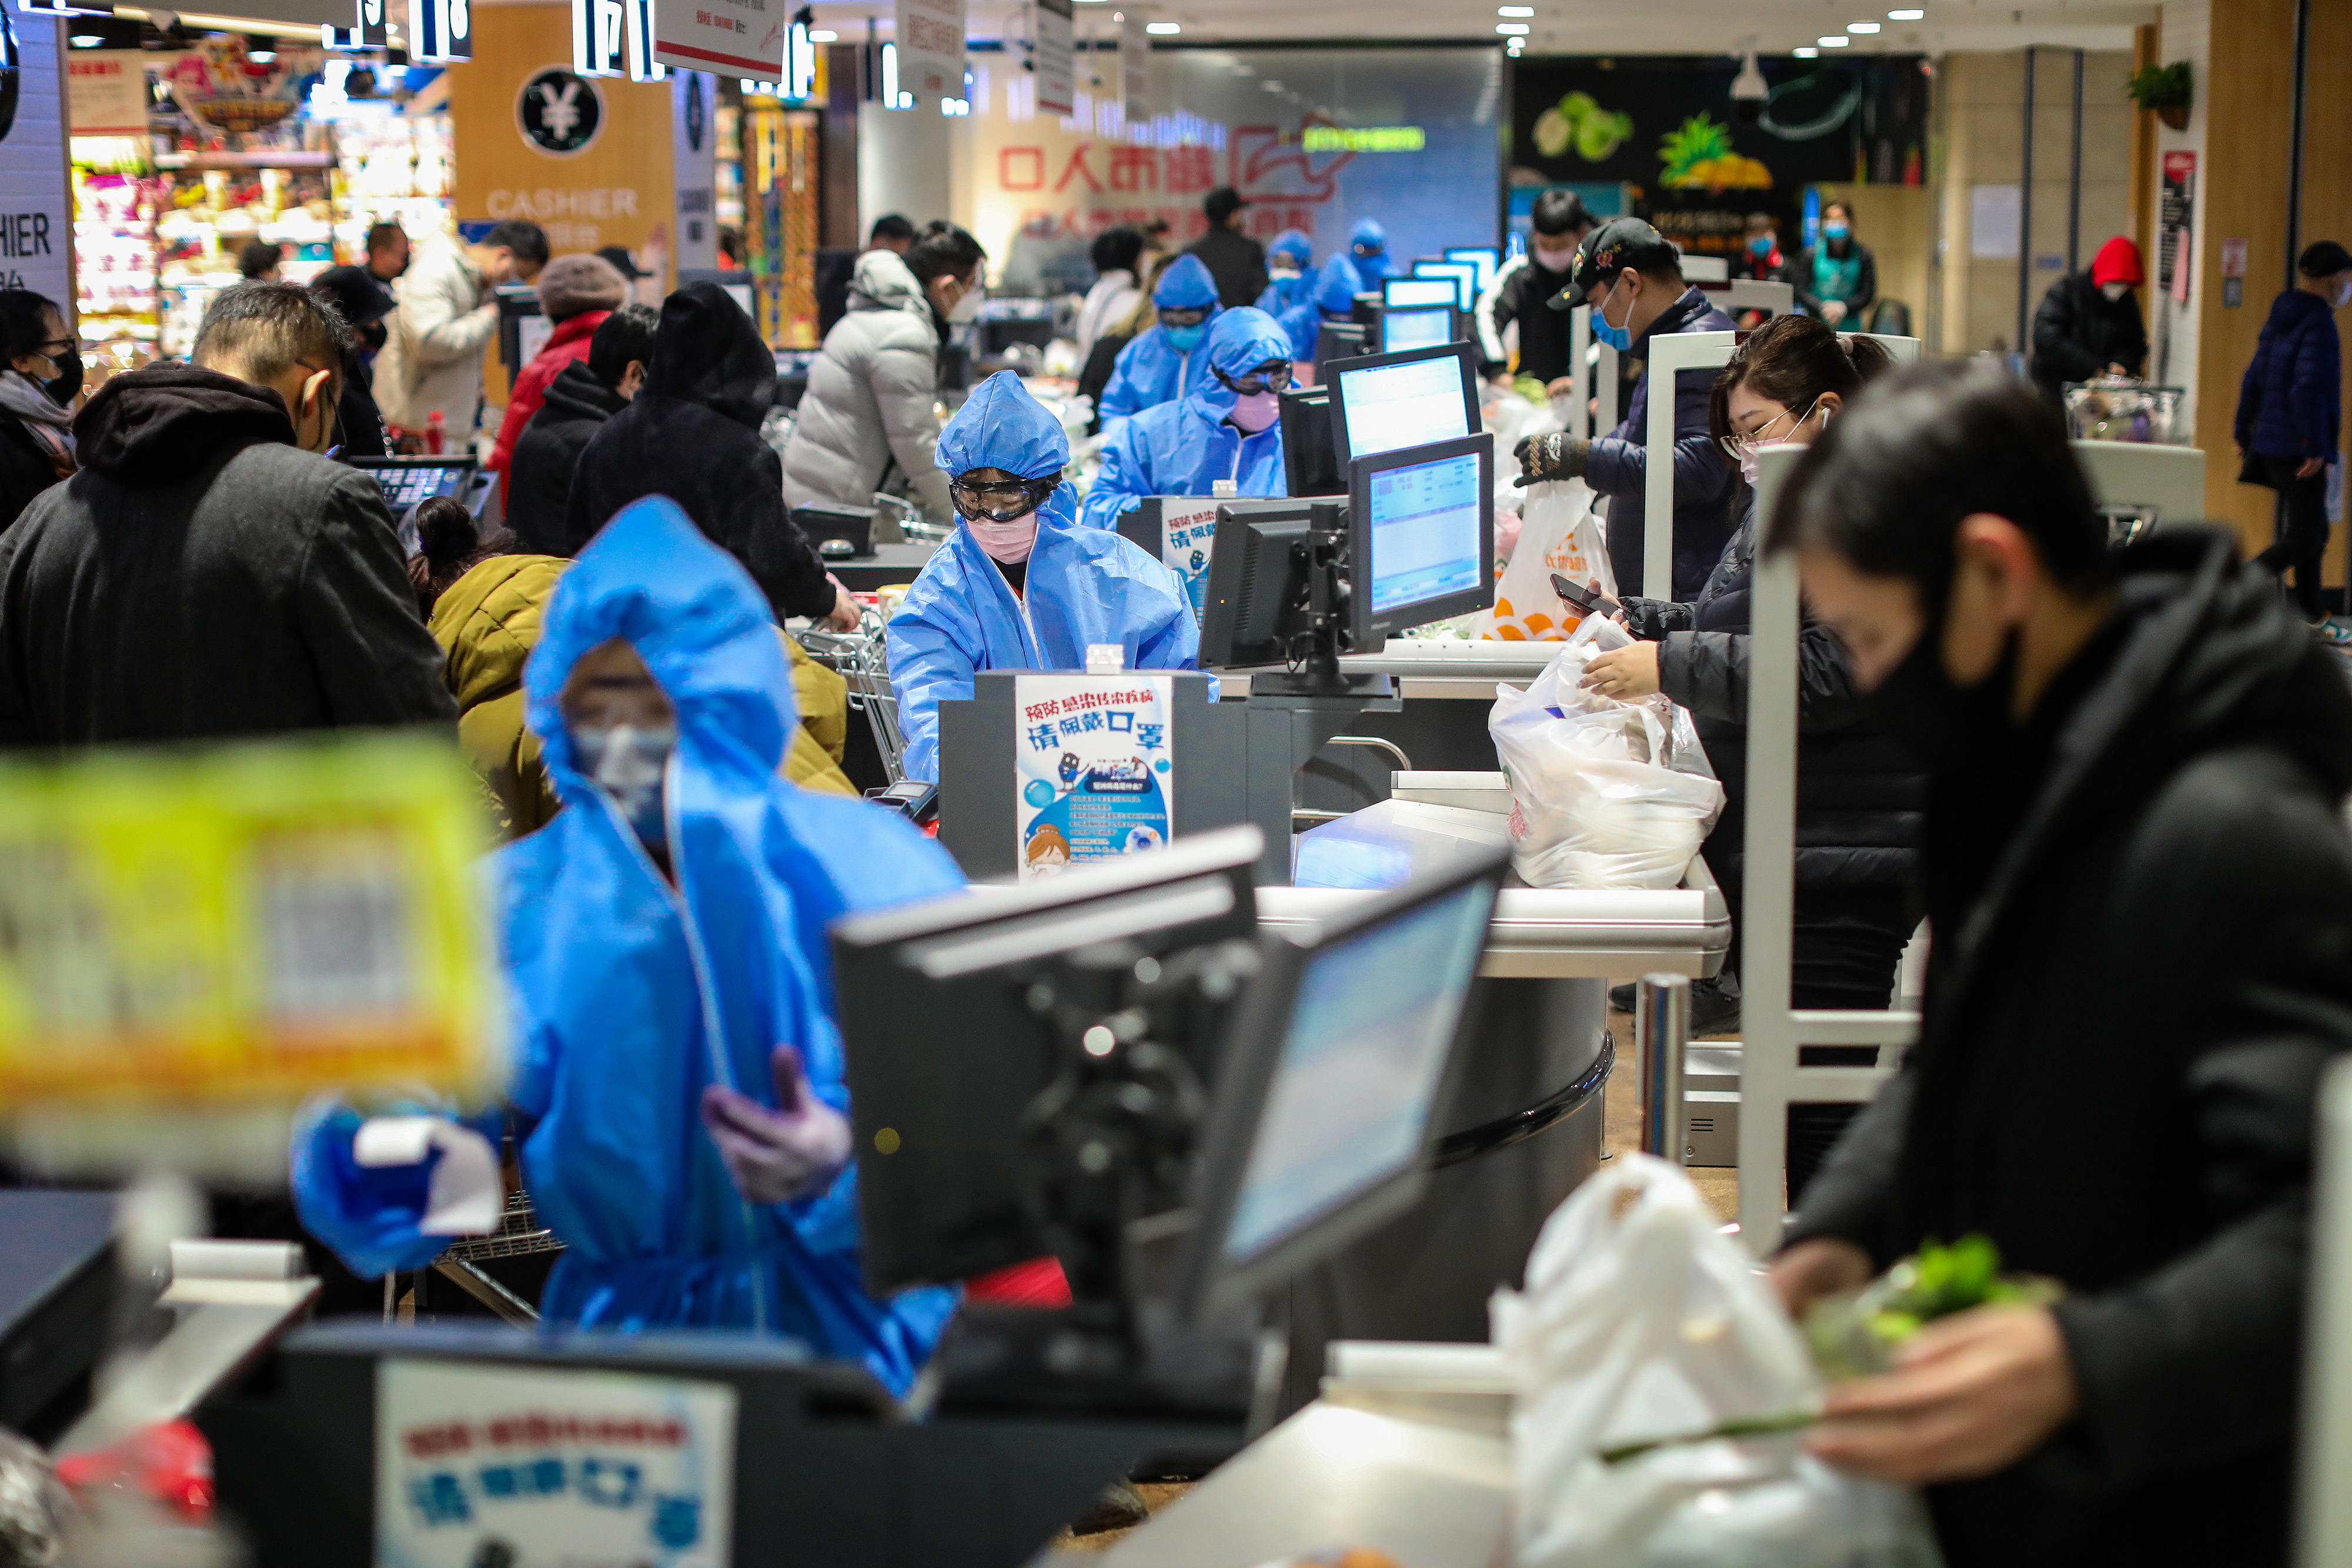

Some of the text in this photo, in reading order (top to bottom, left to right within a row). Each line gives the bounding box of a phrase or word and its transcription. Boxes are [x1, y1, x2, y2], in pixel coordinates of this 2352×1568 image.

[486, 188, 639, 219] CASHIER
[1168, 510, 1217, 530] 预防感染
[1026, 710, 1164, 753] 请佩戴口罩
